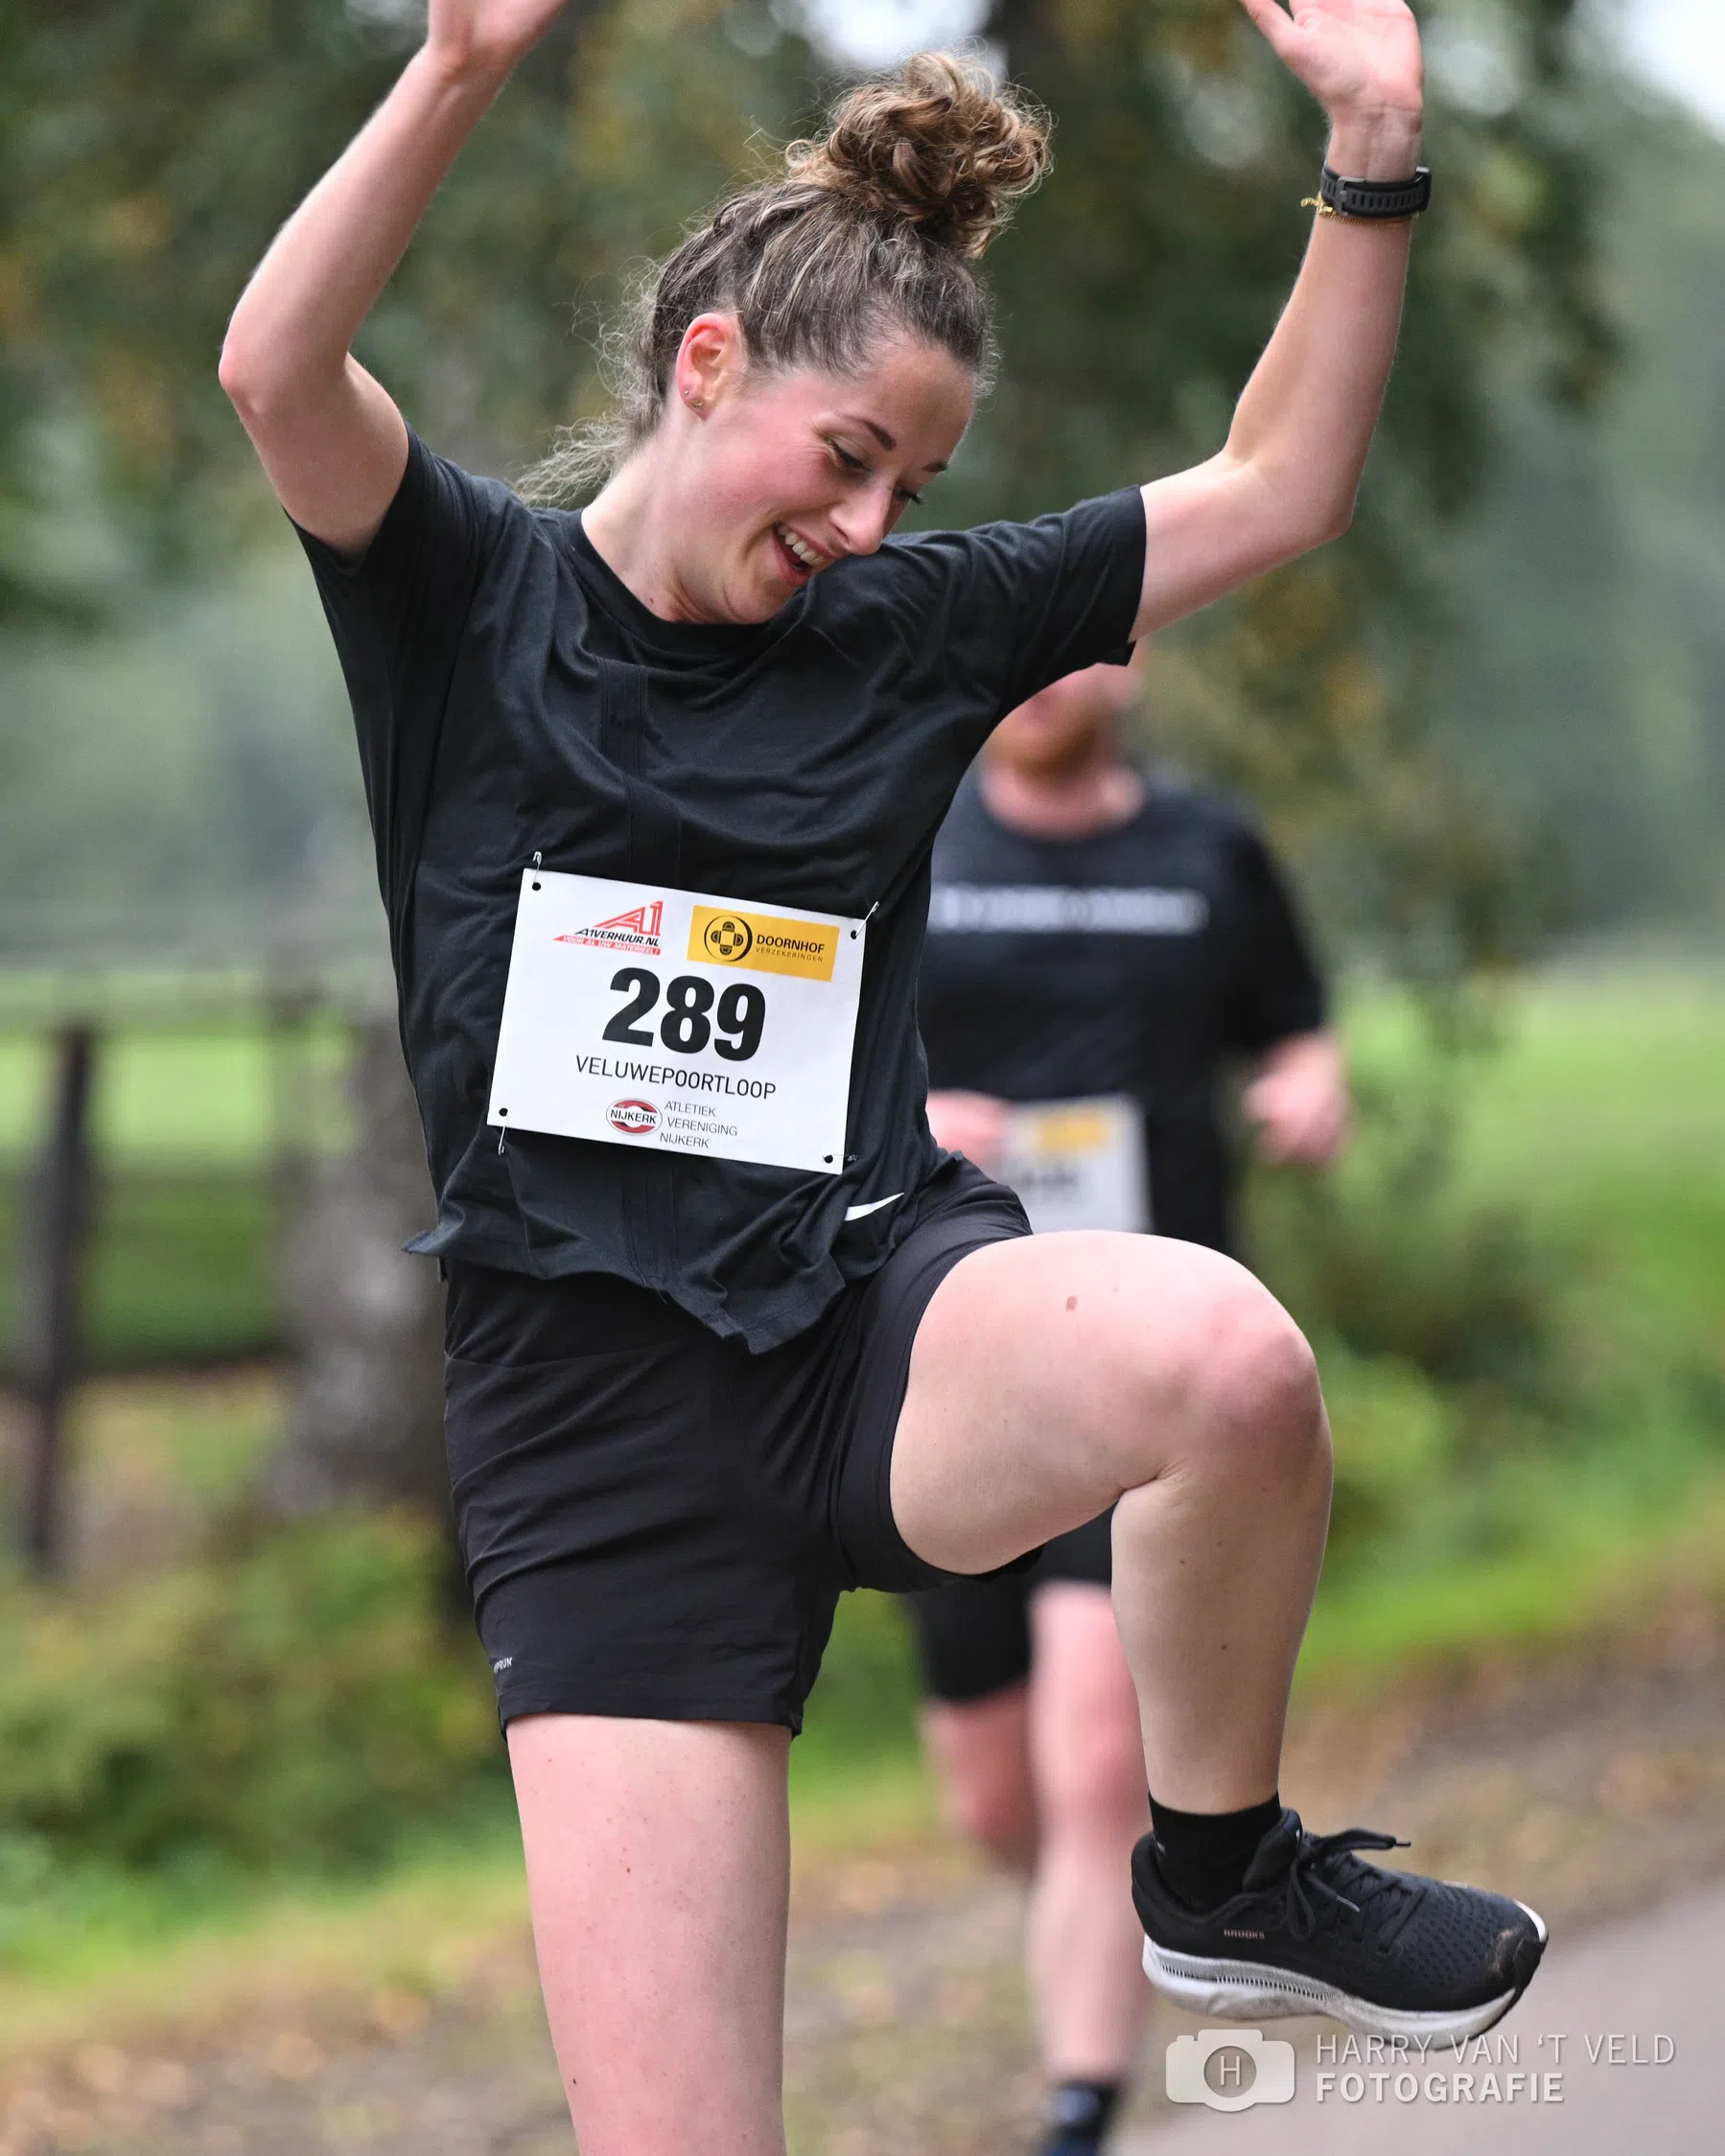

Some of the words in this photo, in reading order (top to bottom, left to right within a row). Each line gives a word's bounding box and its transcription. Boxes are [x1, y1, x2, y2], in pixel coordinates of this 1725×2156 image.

[563, 935, 585, 945] VOOR
[586, 938, 595, 946] AL
[597, 939, 613, 949] UW
[574, 928, 660, 947] A1VERHUUR.NL
[757, 934, 825, 954] DOORNHOF
[756, 946, 824, 962] VERZEKERINGEN
[602, 967, 766, 1061] 289
[576, 1055, 777, 1100] VELUWEPOORTLOOP
[610, 1109, 657, 1124] NIJKERK
[664, 1101, 717, 1118] ATLETIEK
[667, 1117, 738, 1136] VERENIGING
[660, 1132, 710, 1148] NIJKERK
